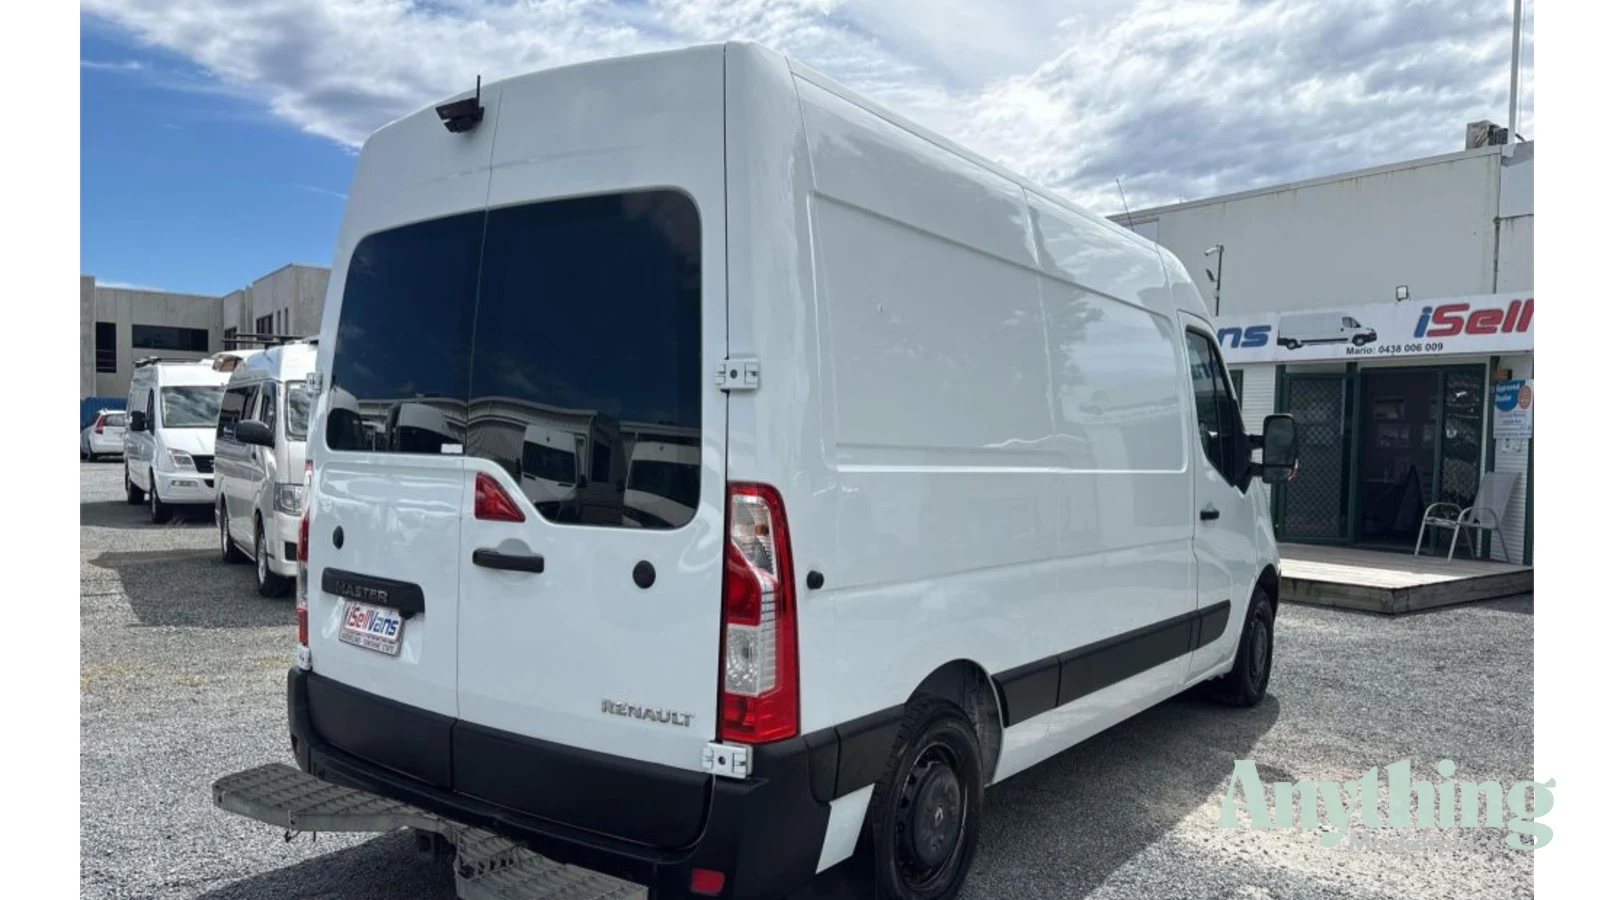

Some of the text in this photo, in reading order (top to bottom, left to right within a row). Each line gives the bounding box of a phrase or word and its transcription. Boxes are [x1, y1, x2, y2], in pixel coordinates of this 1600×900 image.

[1346, 342, 1443, 355] Mario: 0438 006 009
[335, 580, 388, 604] MASTER
[601, 699, 695, 727] RENAULT
